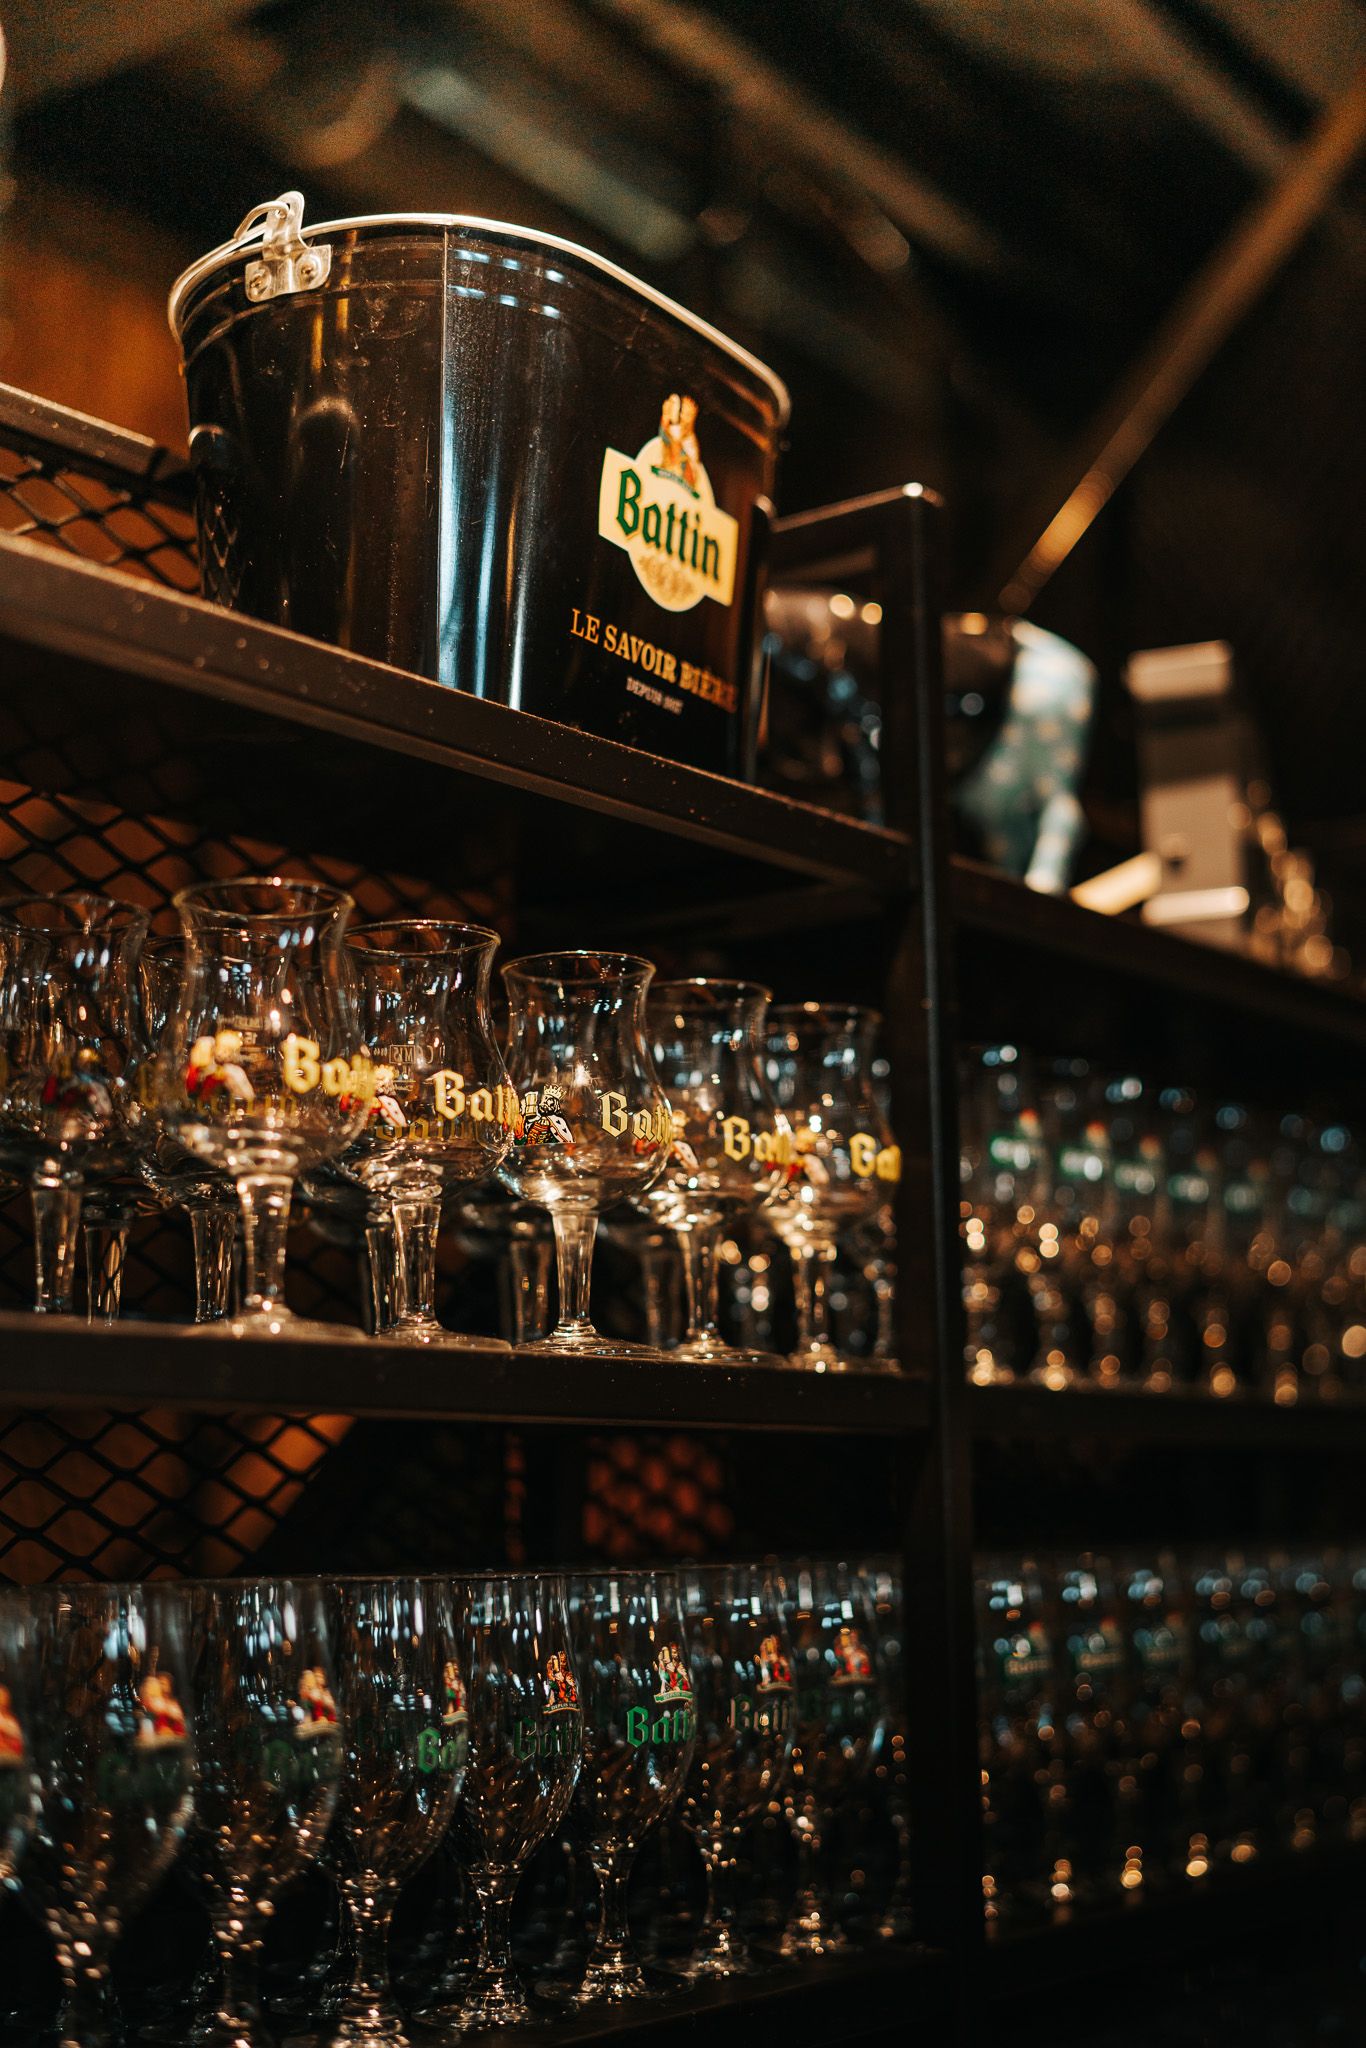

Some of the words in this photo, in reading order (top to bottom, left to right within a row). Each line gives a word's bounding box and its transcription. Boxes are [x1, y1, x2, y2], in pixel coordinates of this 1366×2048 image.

[616, 469, 719, 581] Battin
[570, 608, 601, 645] LE
[603, 624, 677, 684] SAVOIR
